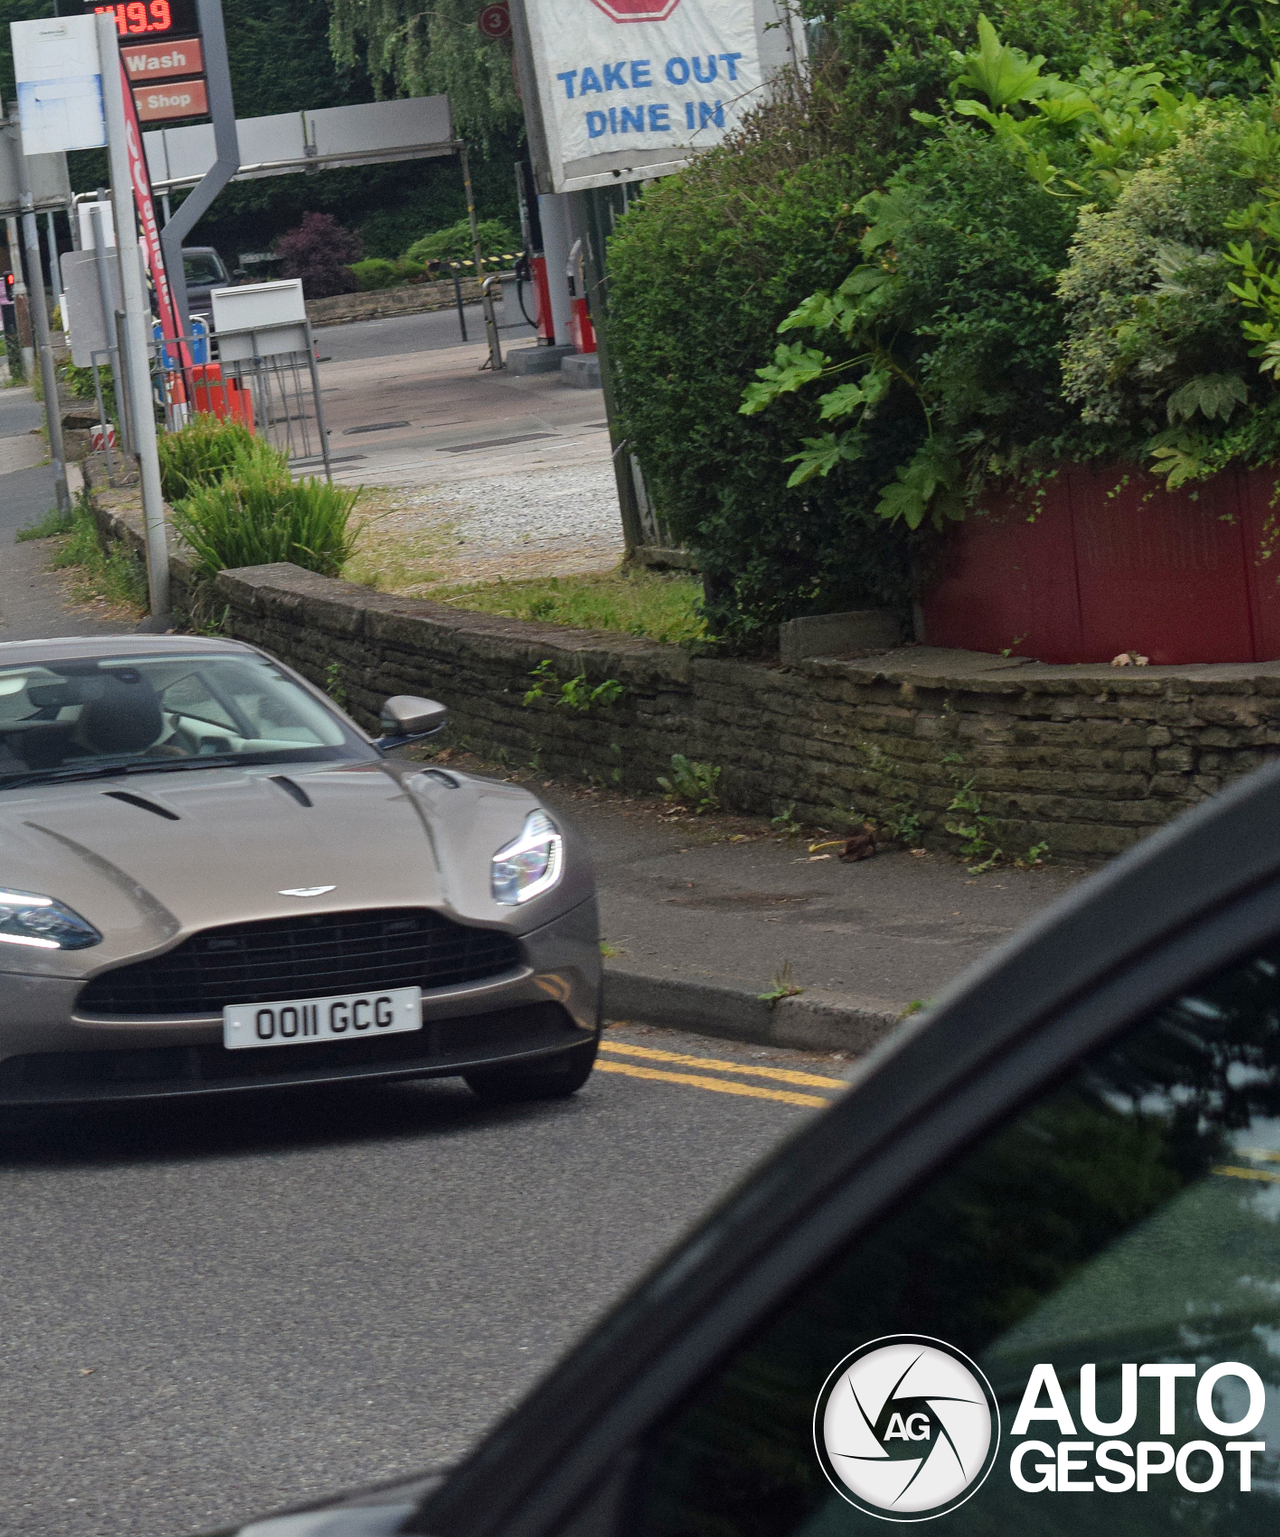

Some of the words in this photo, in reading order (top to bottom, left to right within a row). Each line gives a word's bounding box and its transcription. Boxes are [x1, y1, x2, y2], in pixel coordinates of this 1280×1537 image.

[126, 51, 187, 72] Wash
[557, 59, 652, 99] TAKE
[665, 52, 742, 85] OUT
[148, 94, 191, 109] Shop
[585, 103, 670, 139] DINE
[685, 100, 725, 130] IN
[330, 996, 394, 1033] GCG
